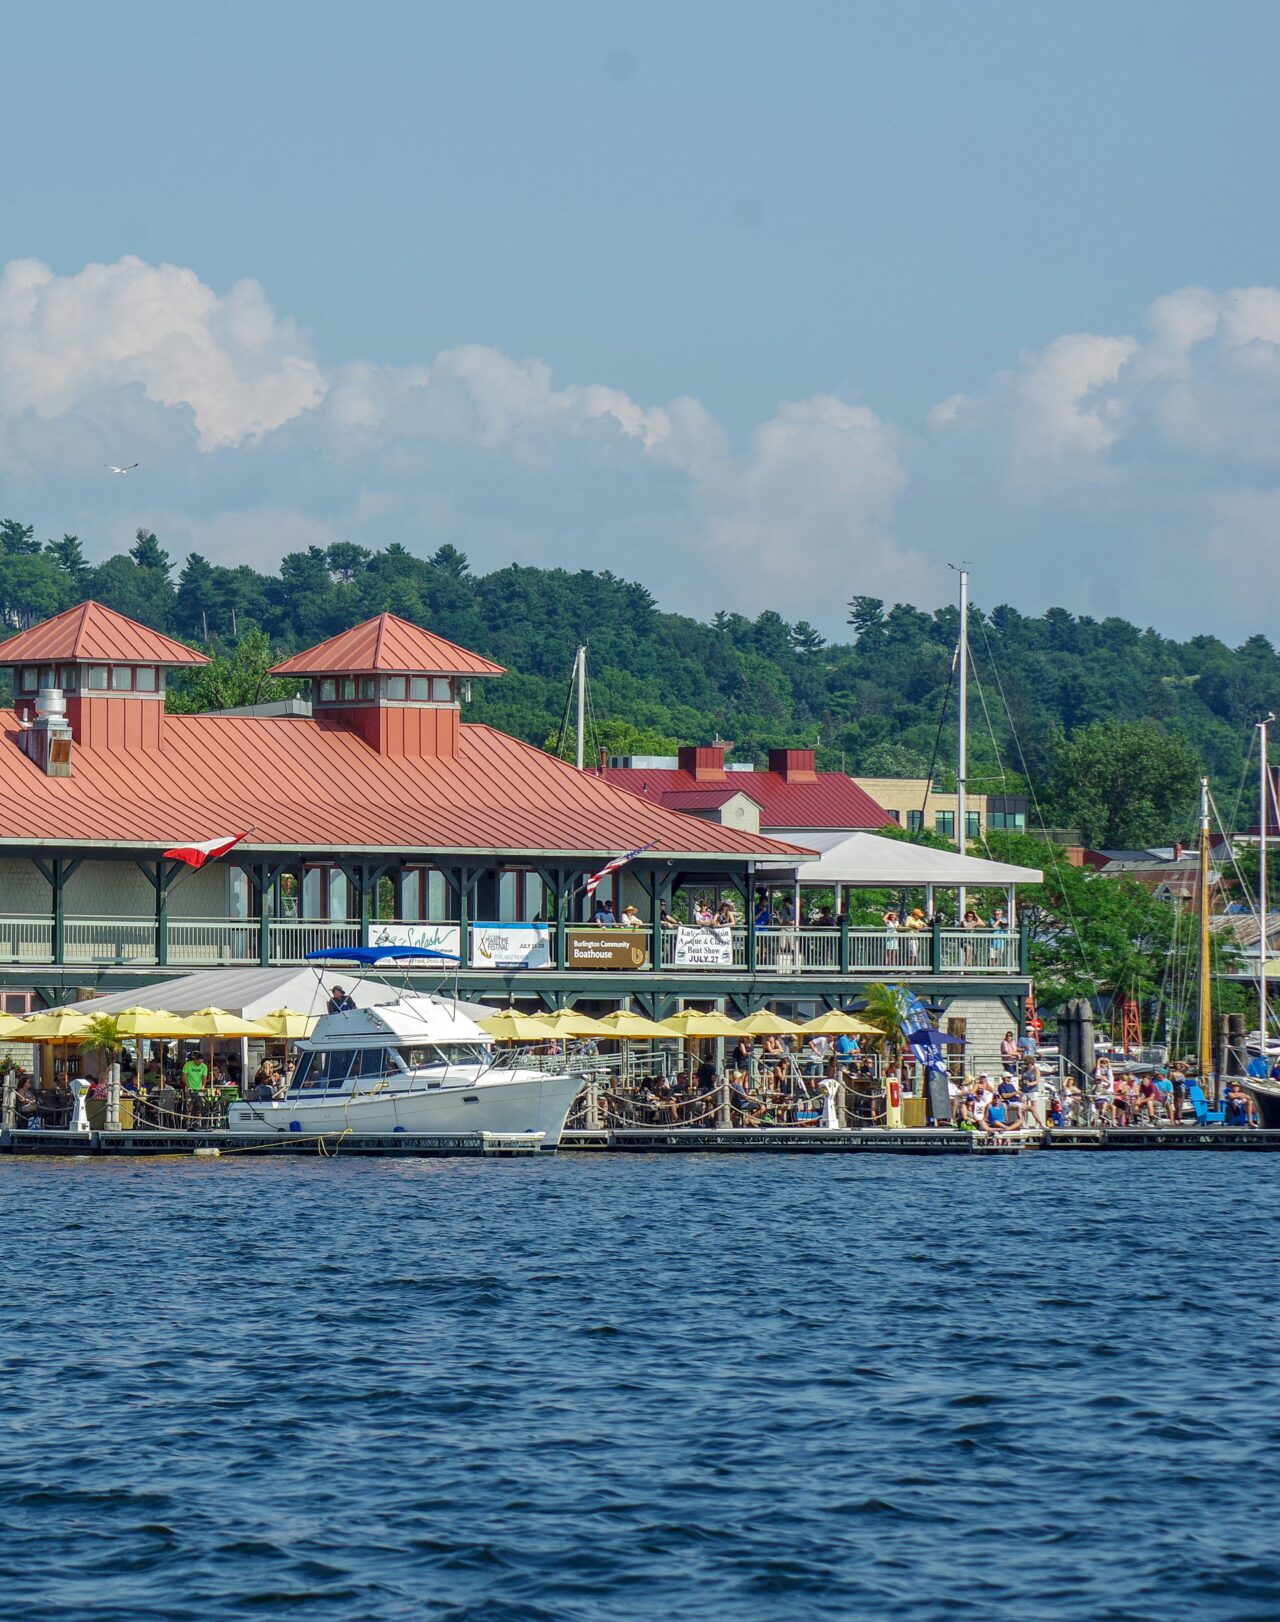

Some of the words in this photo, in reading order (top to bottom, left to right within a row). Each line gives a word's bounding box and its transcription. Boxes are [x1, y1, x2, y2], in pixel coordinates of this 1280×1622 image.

[573, 940, 599, 948] Burlington
[601, 940, 630, 949] Community
[574, 949, 612, 958] Boathouse
